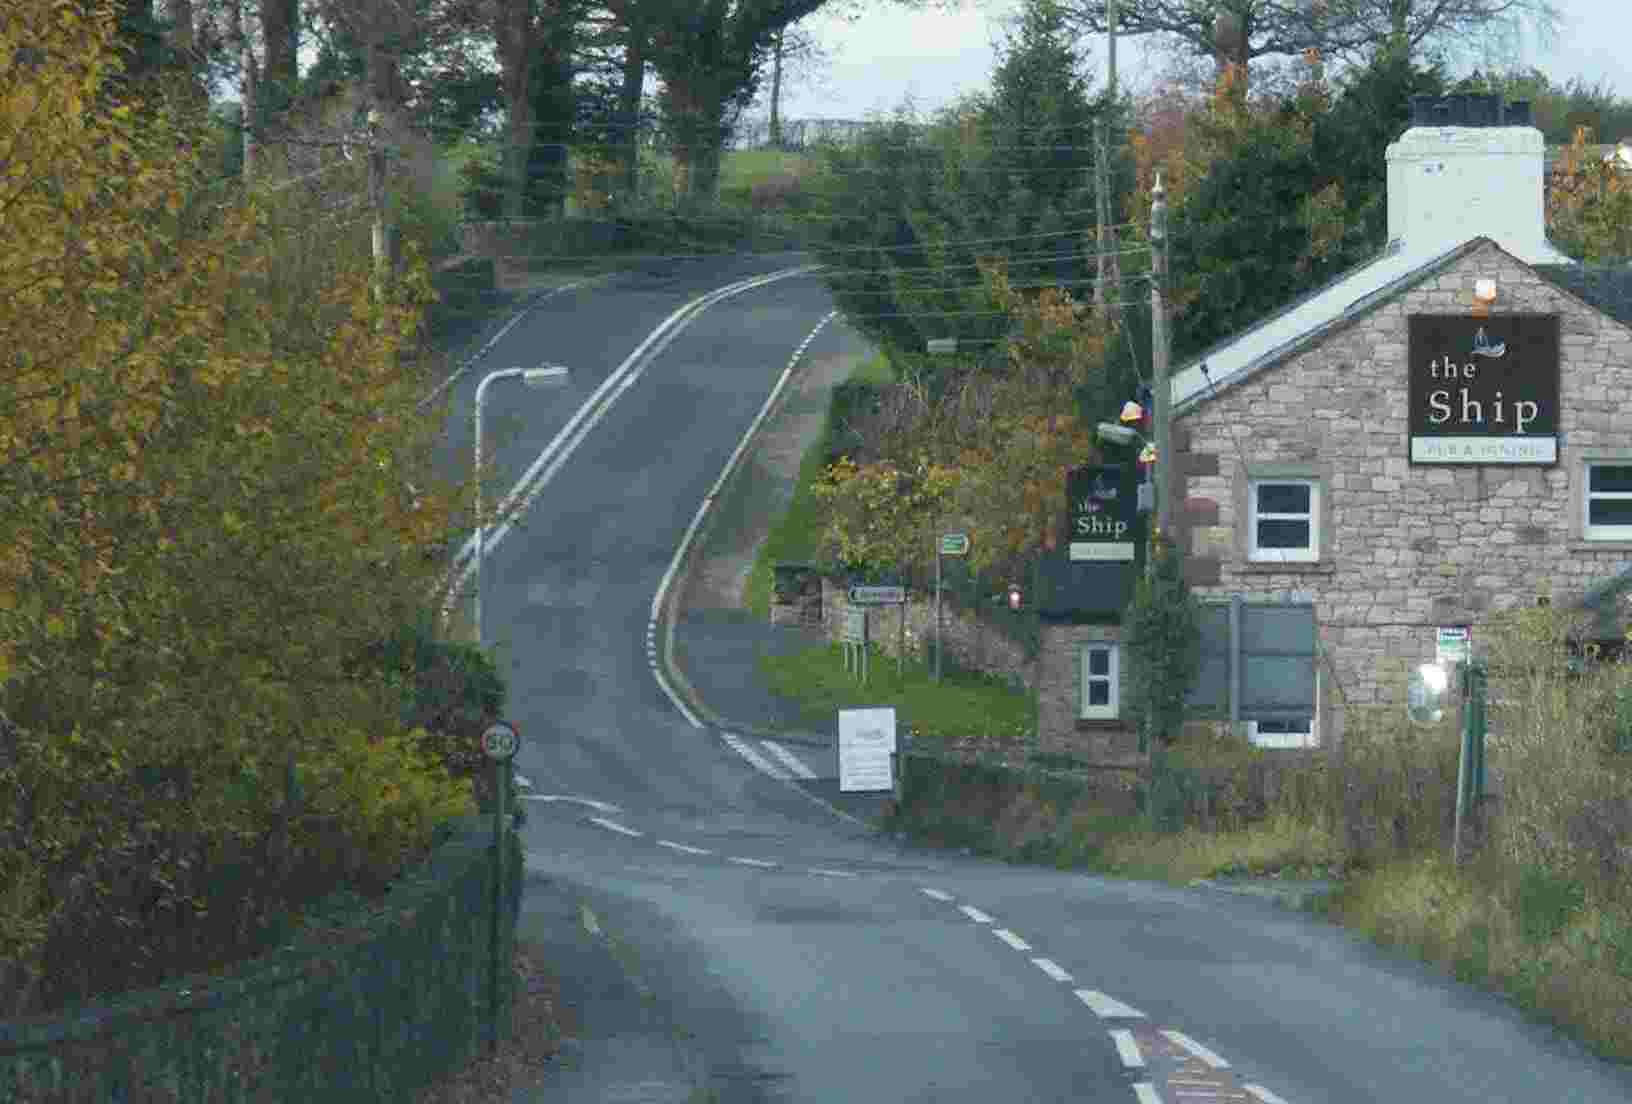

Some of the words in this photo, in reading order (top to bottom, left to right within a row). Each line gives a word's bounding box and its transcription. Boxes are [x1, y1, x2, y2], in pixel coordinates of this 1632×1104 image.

[1430, 355, 1476, 378] the
[1429, 387, 1538, 433] Ship
[1077, 514, 1128, 539] Ship
